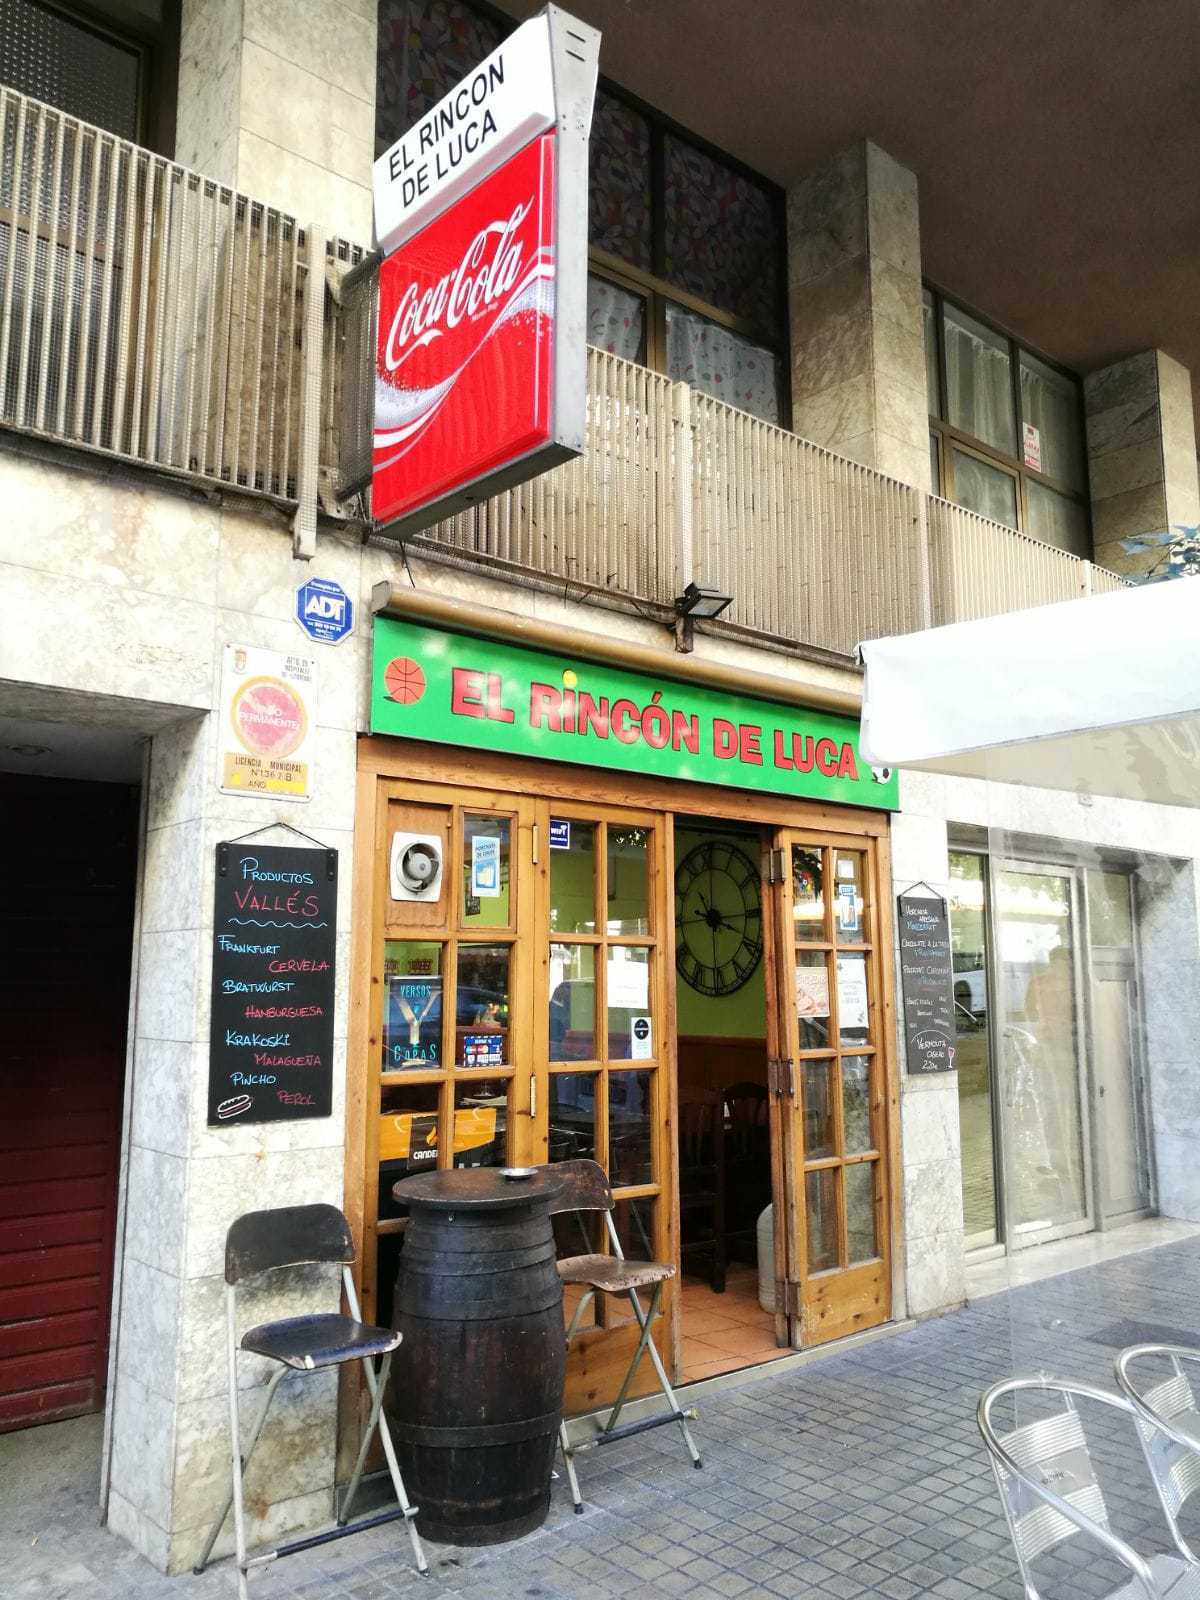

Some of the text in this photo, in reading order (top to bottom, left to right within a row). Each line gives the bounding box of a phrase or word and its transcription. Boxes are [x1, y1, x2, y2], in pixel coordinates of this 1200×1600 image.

[389, 54, 505, 182] EL RINCON
[402, 109, 498, 209] DE LUCA
[385, 195, 535, 372] Coca-Cola
[305, 594, 345, 621] ADT
[240, 711, 298, 731] PERMANENTE
[451, 667, 860, 782] EL RINCÓN DE LUCA
[235, 756, 302, 773] LICENCIA MUNICIPAL
[240, 857, 314, 884] PRODUCTOS
[234, 884, 319, 917] VALLÉS
[217, 934, 280, 954] FRANKFURT
[268, 960, 330, 973] CERVELA
[222, 979, 295, 994] BRATWURST
[400, 984, 432, 997] VERSOS
[244, 1005, 323, 1019] HAMBURGUESA
[254, 1052, 321, 1067] MALAGUEÑA
[394, 1043, 436, 1061] COPAS
[230, 1072, 277, 1086] PINCHO
